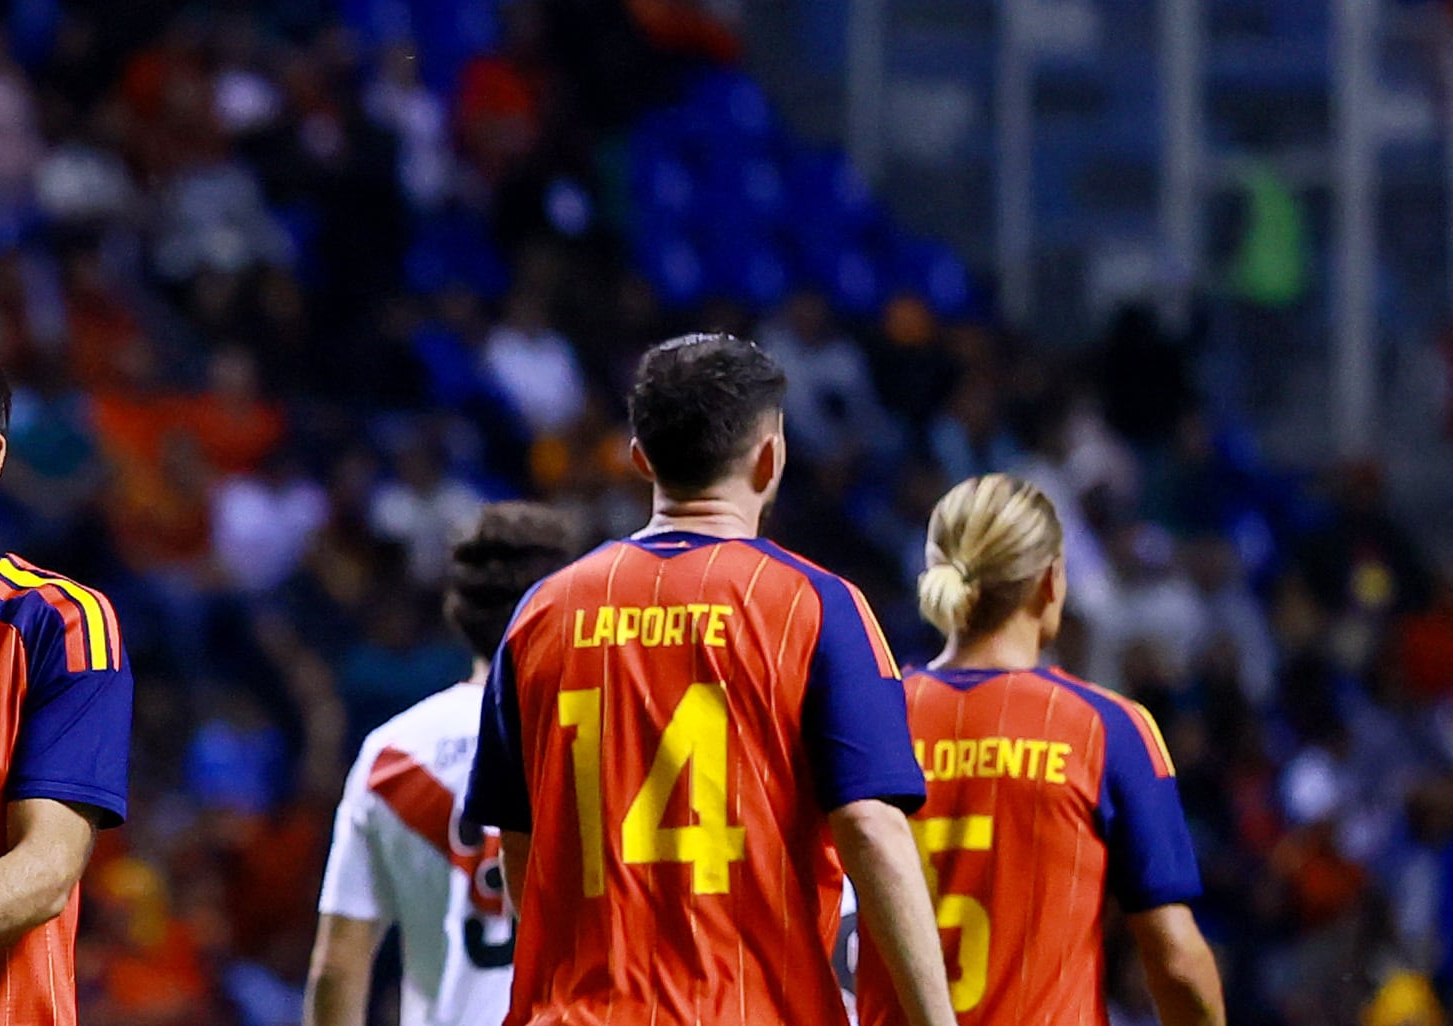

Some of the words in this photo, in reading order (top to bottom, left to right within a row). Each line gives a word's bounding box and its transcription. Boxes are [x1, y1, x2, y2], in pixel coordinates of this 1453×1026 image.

[574, 604, 734, 648] LAPORTE
[557, 683, 746, 898] 14
[909, 815, 994, 1013] 5
